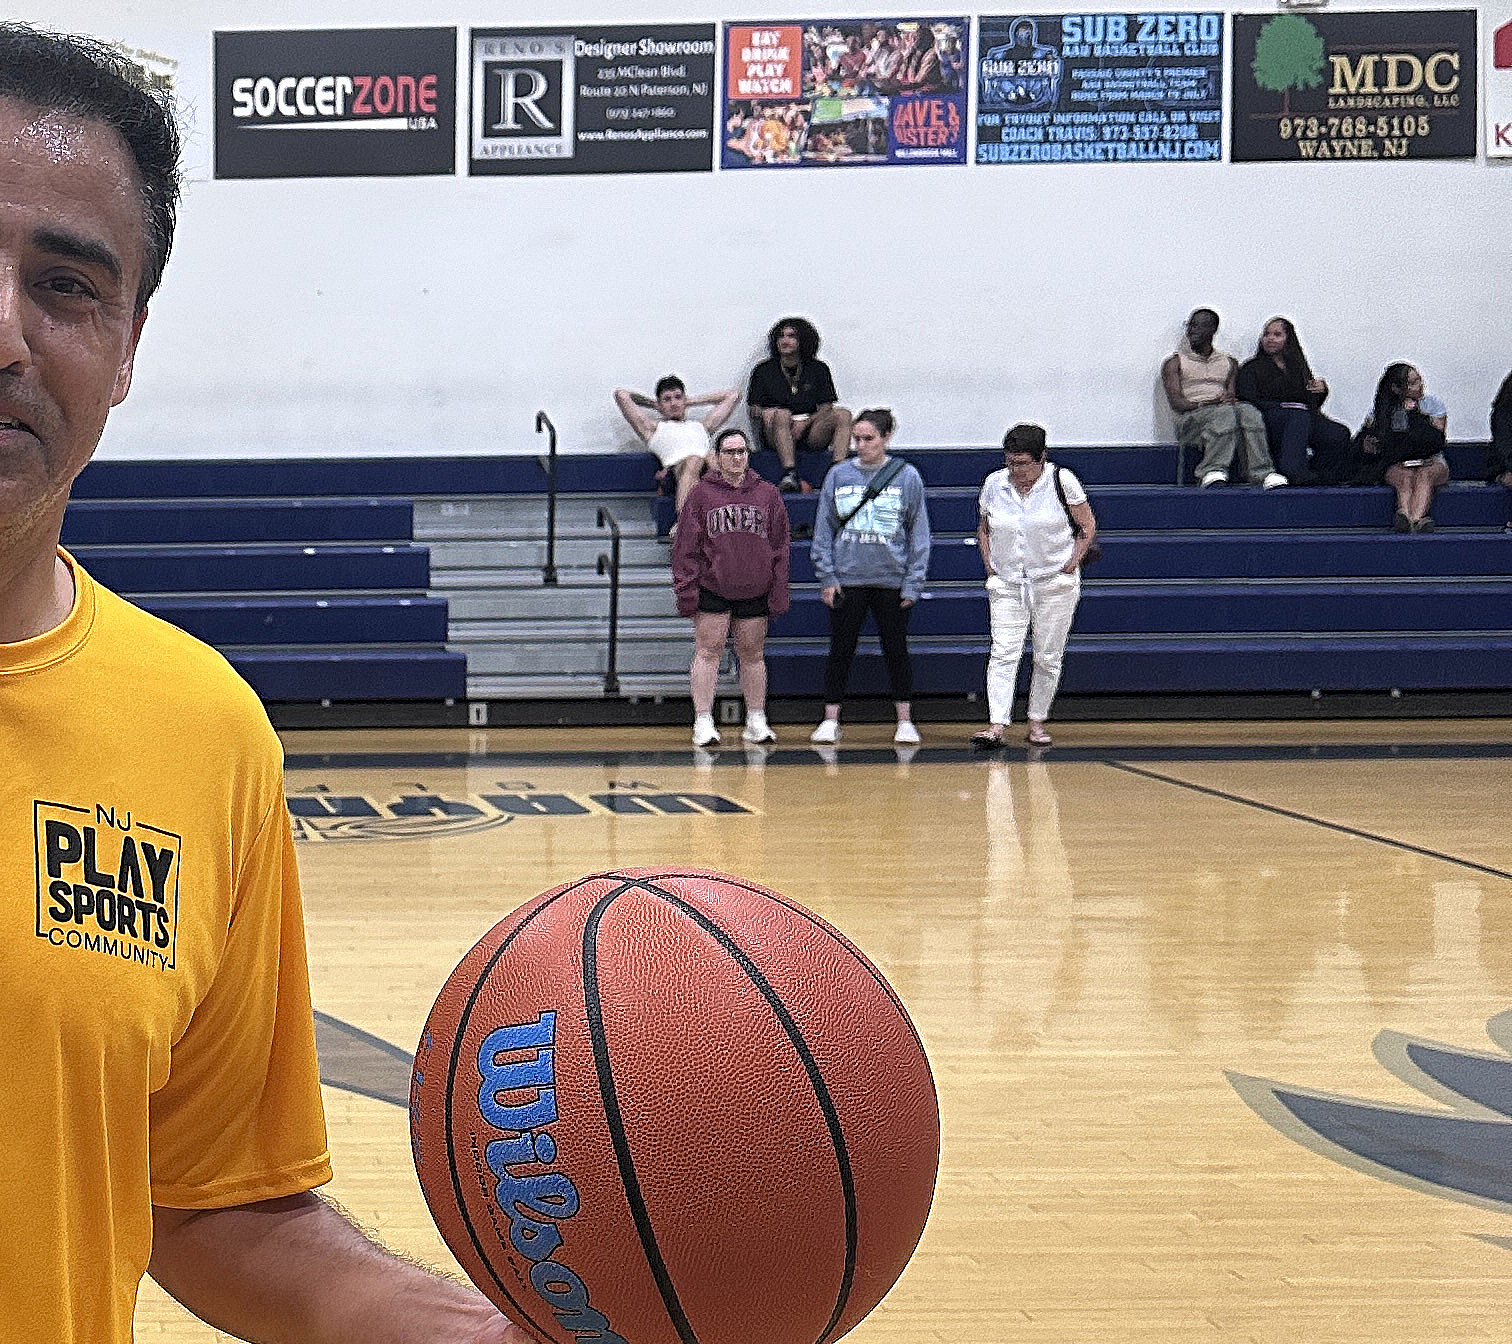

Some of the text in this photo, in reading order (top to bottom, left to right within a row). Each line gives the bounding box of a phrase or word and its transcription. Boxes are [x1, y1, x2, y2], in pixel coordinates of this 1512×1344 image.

[751, 30, 782, 47] EAT
[1061, 14, 1220, 43] SUB ZERO
[574, 38, 714, 60] Designer Showroom
[741, 46, 790, 62] DRINK
[1092, 42, 1182, 56] BASKETBALL
[1184, 42, 1220, 55] CLUB
[747, 63, 787, 77] PLAY
[1328, 52, 1460, 95] MDC
[738, 78, 793, 94] WATCH
[491, 67, 555, 130] R
[1328, 95, 1460, 109] LANDSCAPING, LLC
[408, 118, 438, 130] USA
[1004, 112, 1051, 125] TRYOUT
[1052, 111, 1137, 124] INFORMATION
[1138, 111, 1167, 123] CALL
[1189, 110, 1221, 123] VISIT
[1278, 115, 1430, 139] 973-768-5105
[1001, 127, 1044, 142] COACH
[480, 143, 563, 156] APPLIANCE
[976, 140, 1220, 161] SUBZEROBASKETBALLNJ.COM
[1298, 138, 1410, 158] WAYNE, NJ
[95, 803, 131, 832] NJ
[45, 819, 174, 905] PLAY
[48, 880, 170, 949] SPORTS
[48, 927, 169, 973] COMMUNITY
